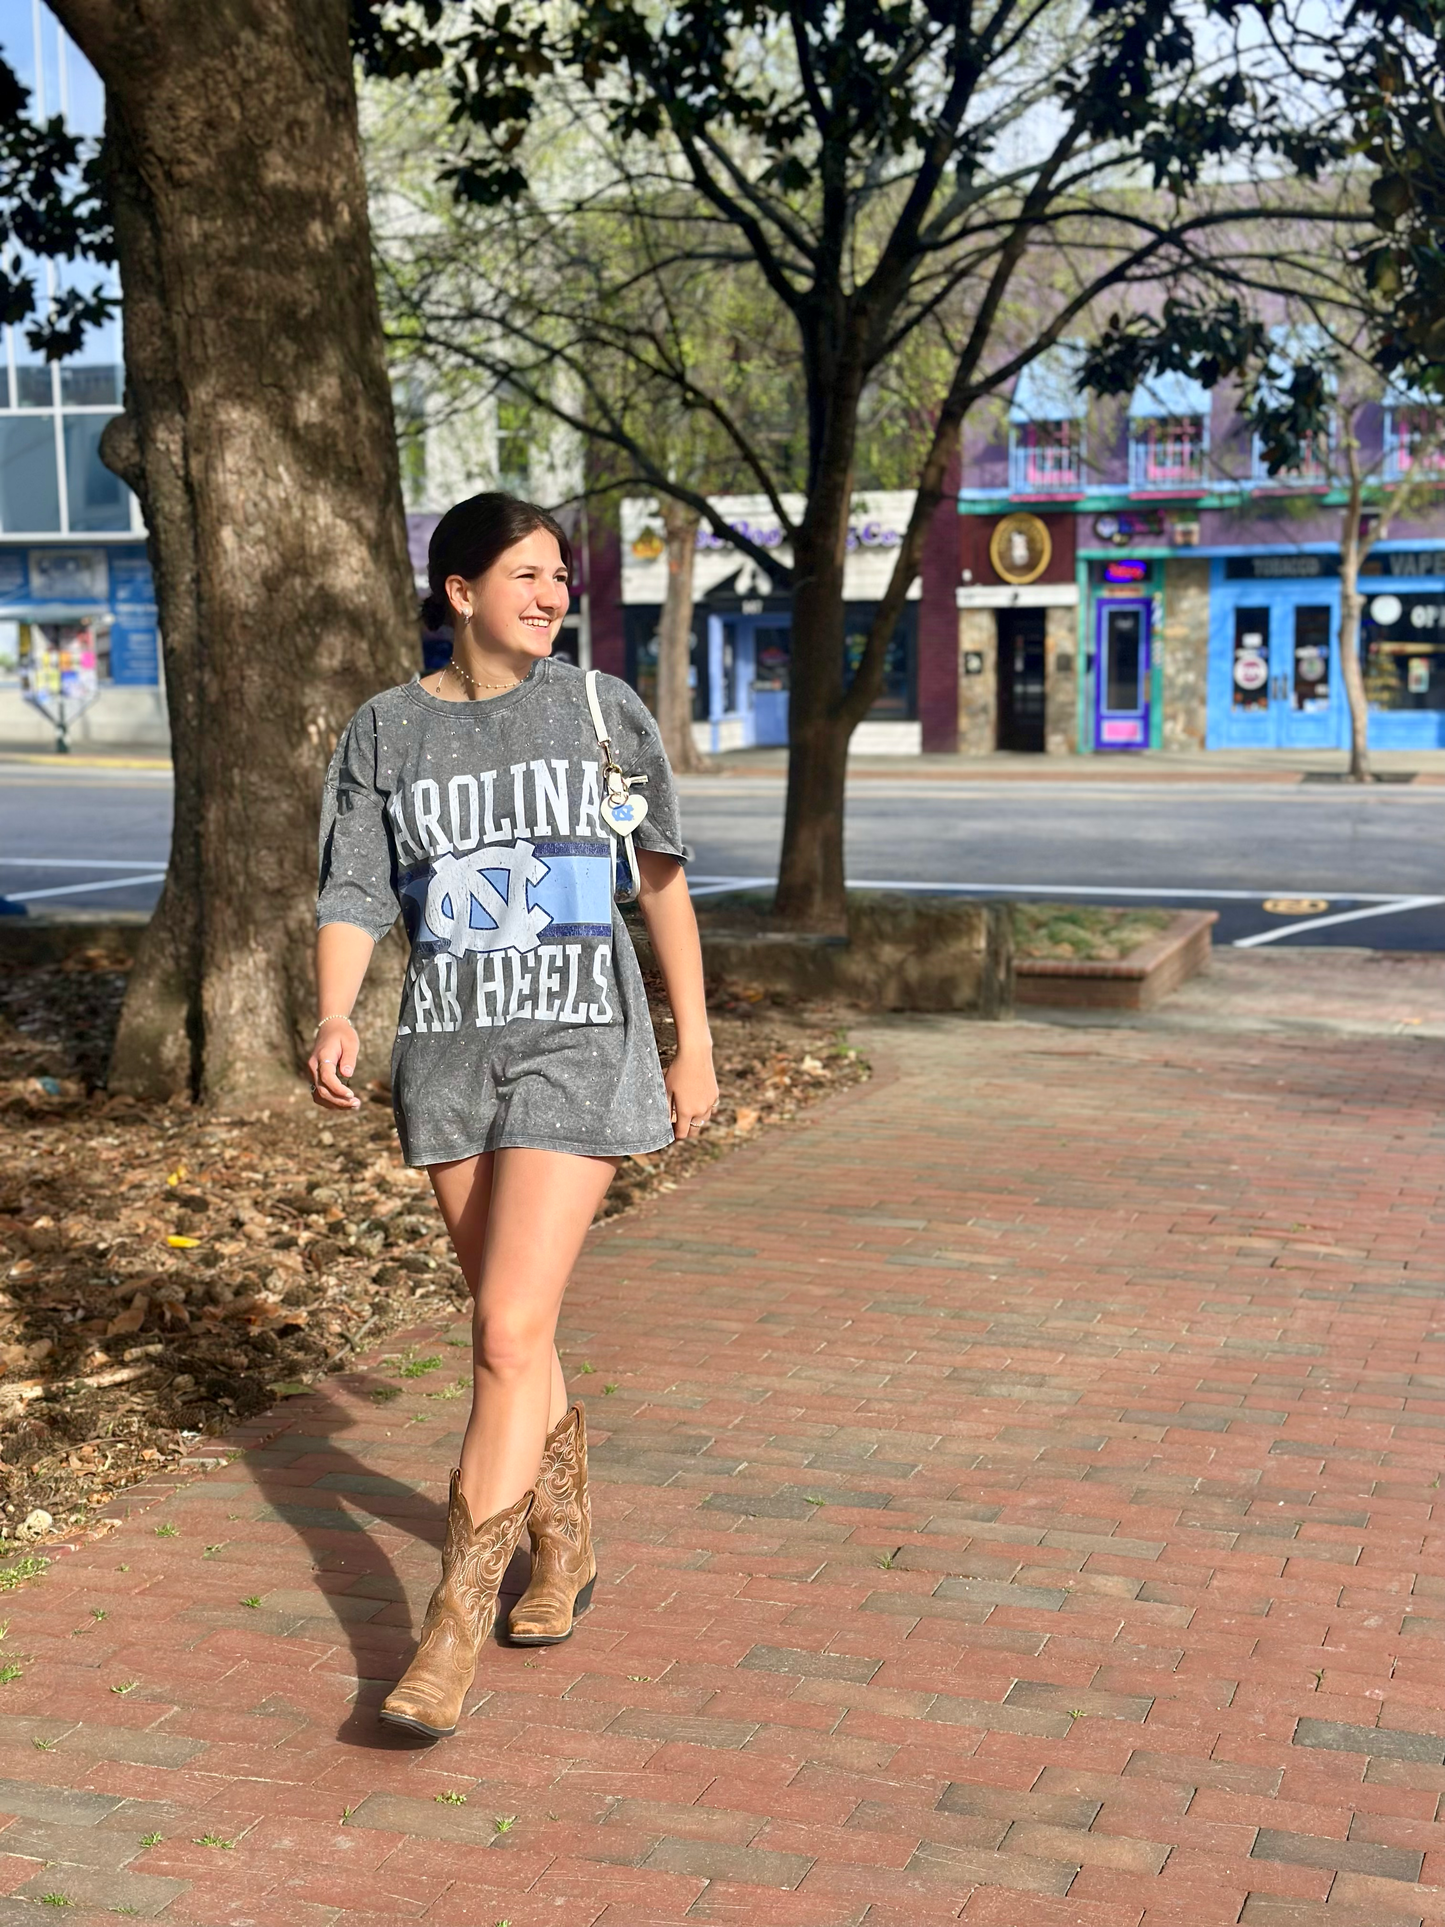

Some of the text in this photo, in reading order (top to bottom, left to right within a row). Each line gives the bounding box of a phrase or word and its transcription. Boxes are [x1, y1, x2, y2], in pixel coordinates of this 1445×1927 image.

[1252, 557, 1321, 577] TOBACCO
[389, 759, 610, 867] AROLINA
[475, 943, 614, 1029] HEELS
